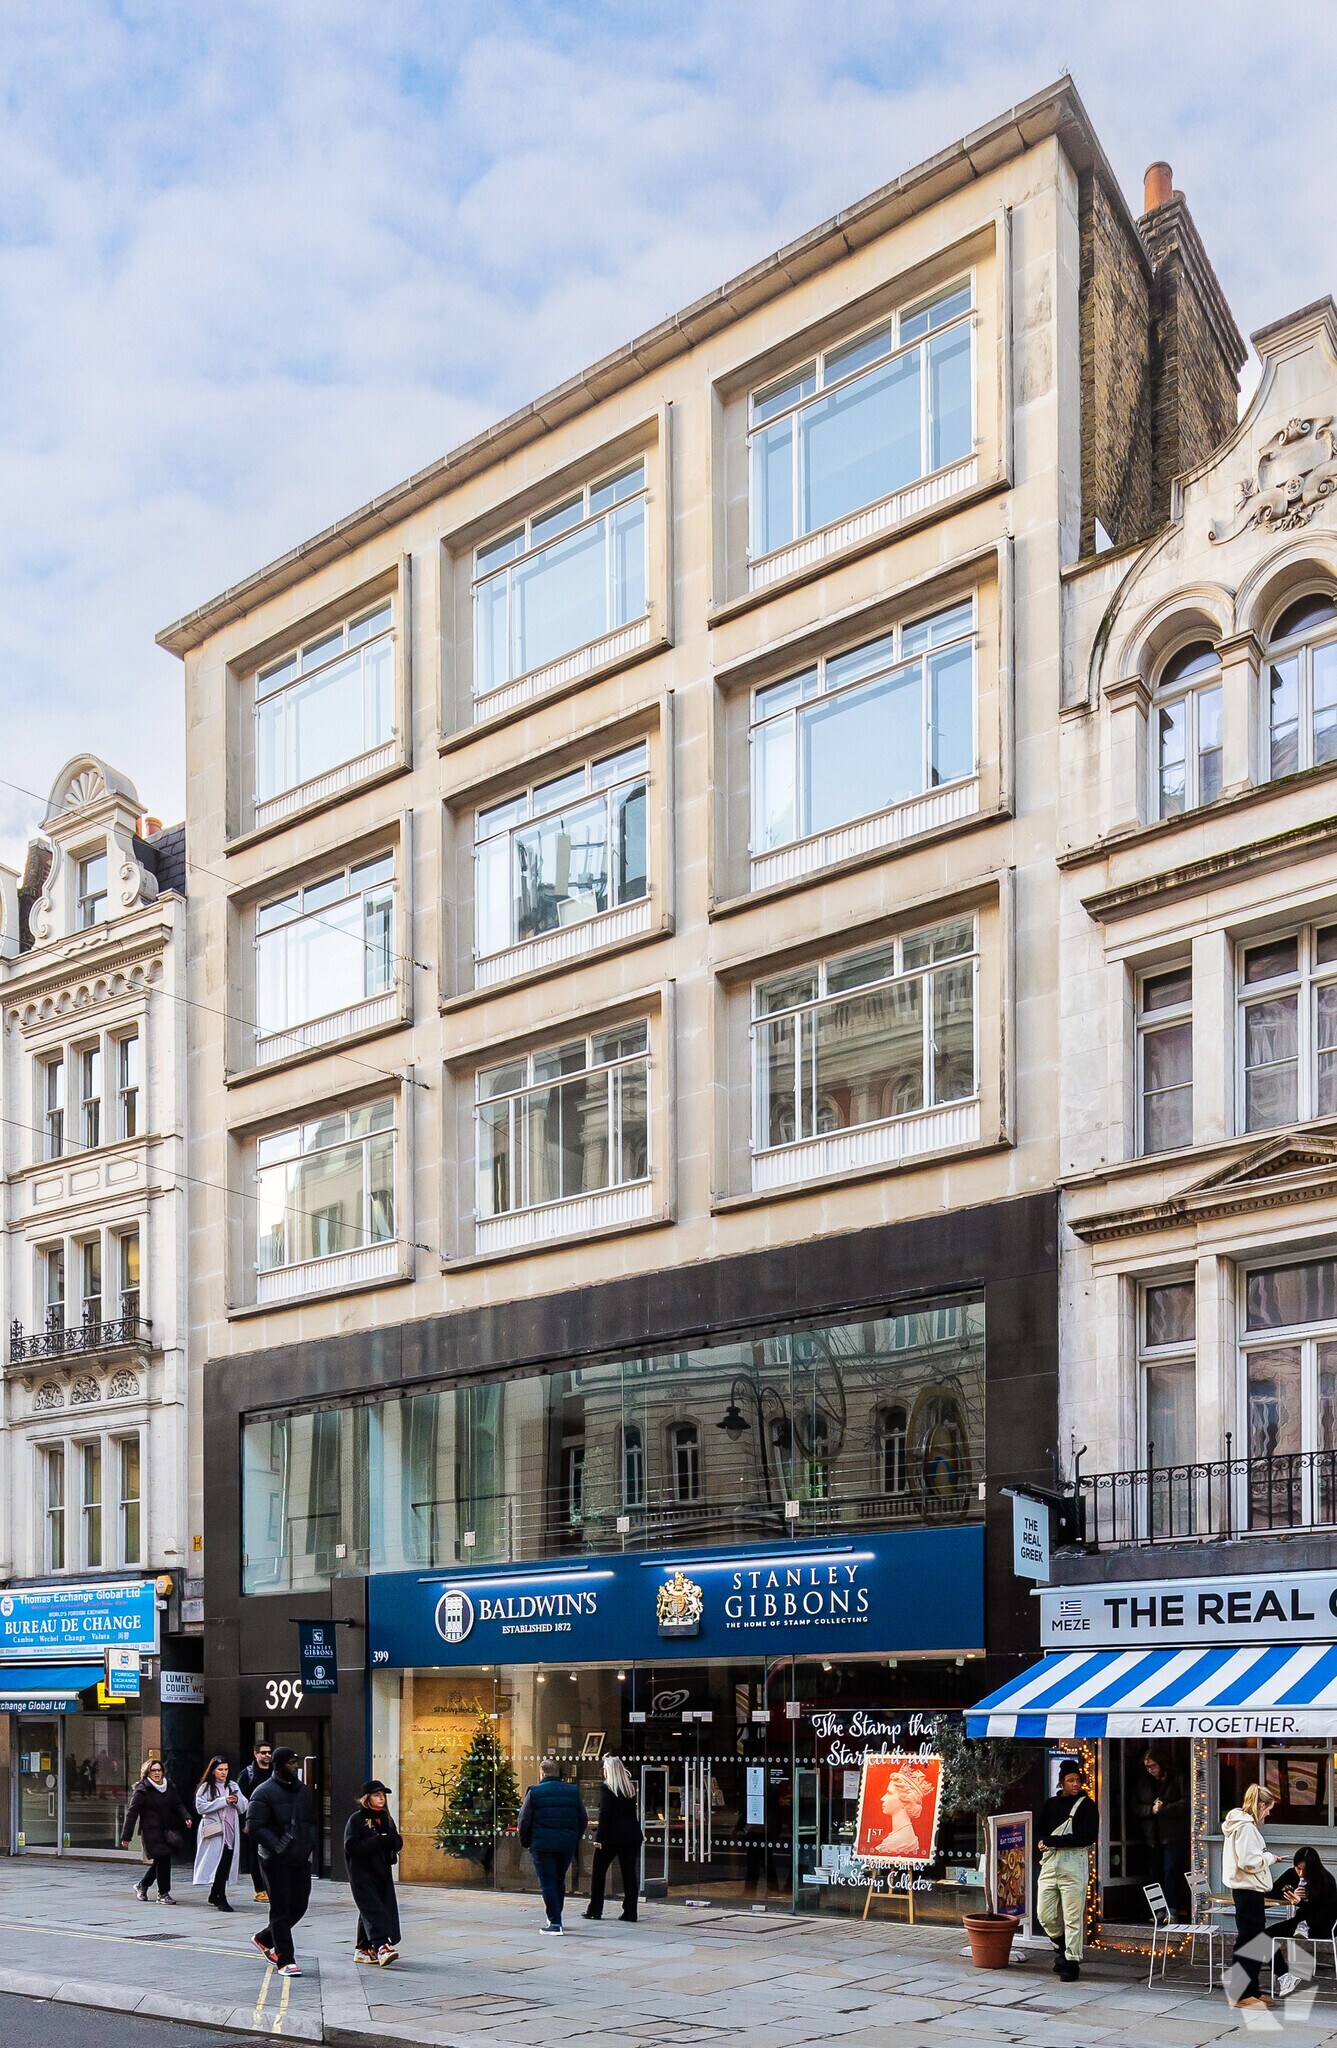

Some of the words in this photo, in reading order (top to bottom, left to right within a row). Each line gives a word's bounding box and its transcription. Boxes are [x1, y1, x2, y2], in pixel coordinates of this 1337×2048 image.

[1024, 1517, 1038, 1532] THE
[1023, 1531, 1042, 1547] REAL
[1020, 1546, 1044, 1563] GREEK
[732, 1564, 859, 1590] STANLEY
[20, 1595, 51, 1604] Thomas
[53, 1592, 94, 1603] Exchange
[96, 1588, 124, 1600] Global
[126, 1587, 141, 1598] Ltd
[724, 1588, 869, 1618] GIBBONS
[478, 1592, 597, 1620] BALDWIN'S
[1103, 1595, 1184, 1629] THE
[1198, 1588, 1315, 1626] REAL
[5, 1619, 57, 1635] BUREAU
[61, 1618, 79, 1632] DE
[83, 1614, 142, 1631] CHANGE
[502, 1624, 553, 1634] ESTABLISHED
[554, 1622, 571, 1632] 1872
[784, 1619, 811, 1627] STAMP
[815, 1616, 869, 1625] COLLECTING
[1051, 1618, 1091, 1631] MEZE
[64, 1634, 86, 1642] Change
[372, 1650, 389, 1663] 399
[166, 1674, 194, 1684] LUMLEY
[165, 1684, 190, 1693] COURT
[265, 1679, 304, 1710] 399
[0, 1701, 27, 1713] change
[28, 1701, 53, 1710] Global
[54, 1701, 67, 1710] Ltd
[812, 1711, 844, 1738] The
[848, 1711, 901, 1744] Stamp
[1141, 1718, 1179, 1733] EAT.
[1187, 1717, 1300, 1733] TOGETHER.
[827, 1740, 887, 1766] Started
[829, 1870, 846, 1887] the
[848, 1868, 884, 1893] Stamp
[886, 1870, 933, 1892] Collector
